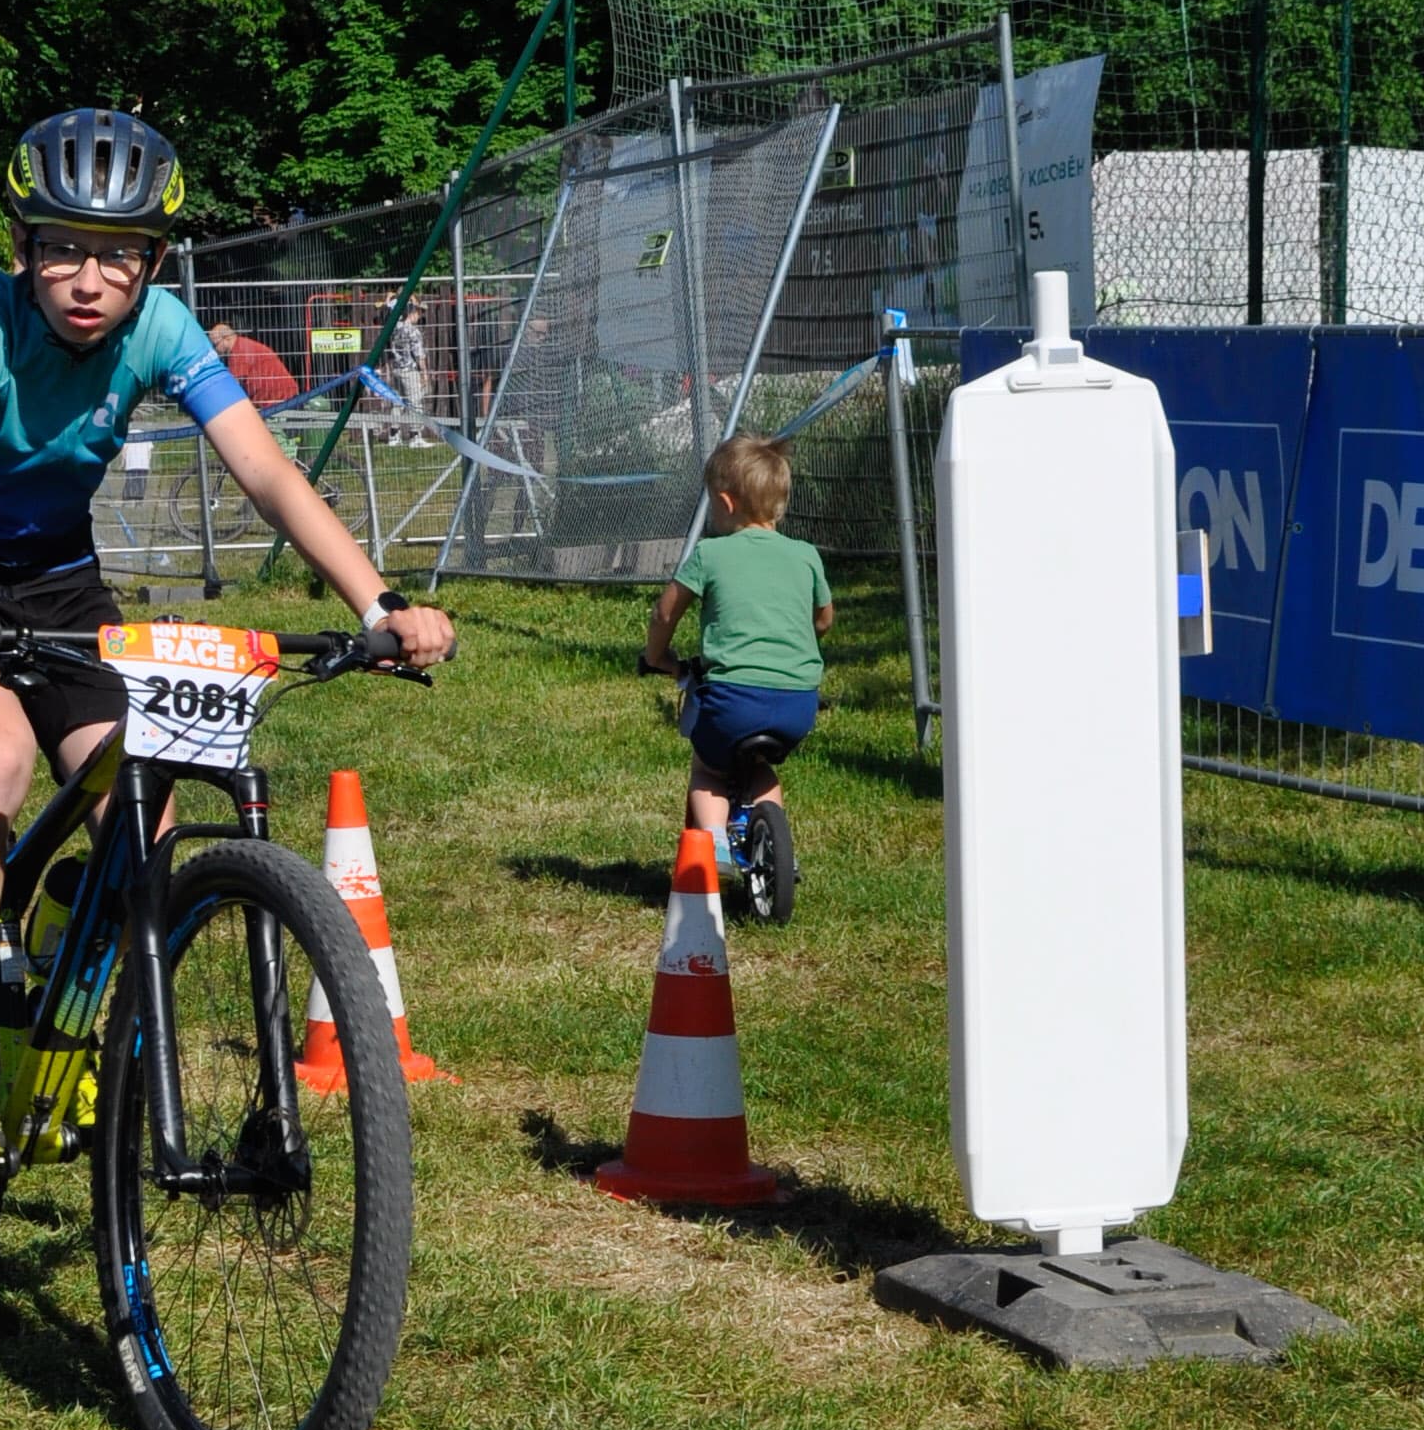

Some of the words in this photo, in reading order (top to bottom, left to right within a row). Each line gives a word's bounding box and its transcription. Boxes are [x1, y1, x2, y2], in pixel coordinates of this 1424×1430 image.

[181, 625, 221, 642] KIDS
[152, 638, 237, 670] RACE
[144, 674, 249, 727] 2081
